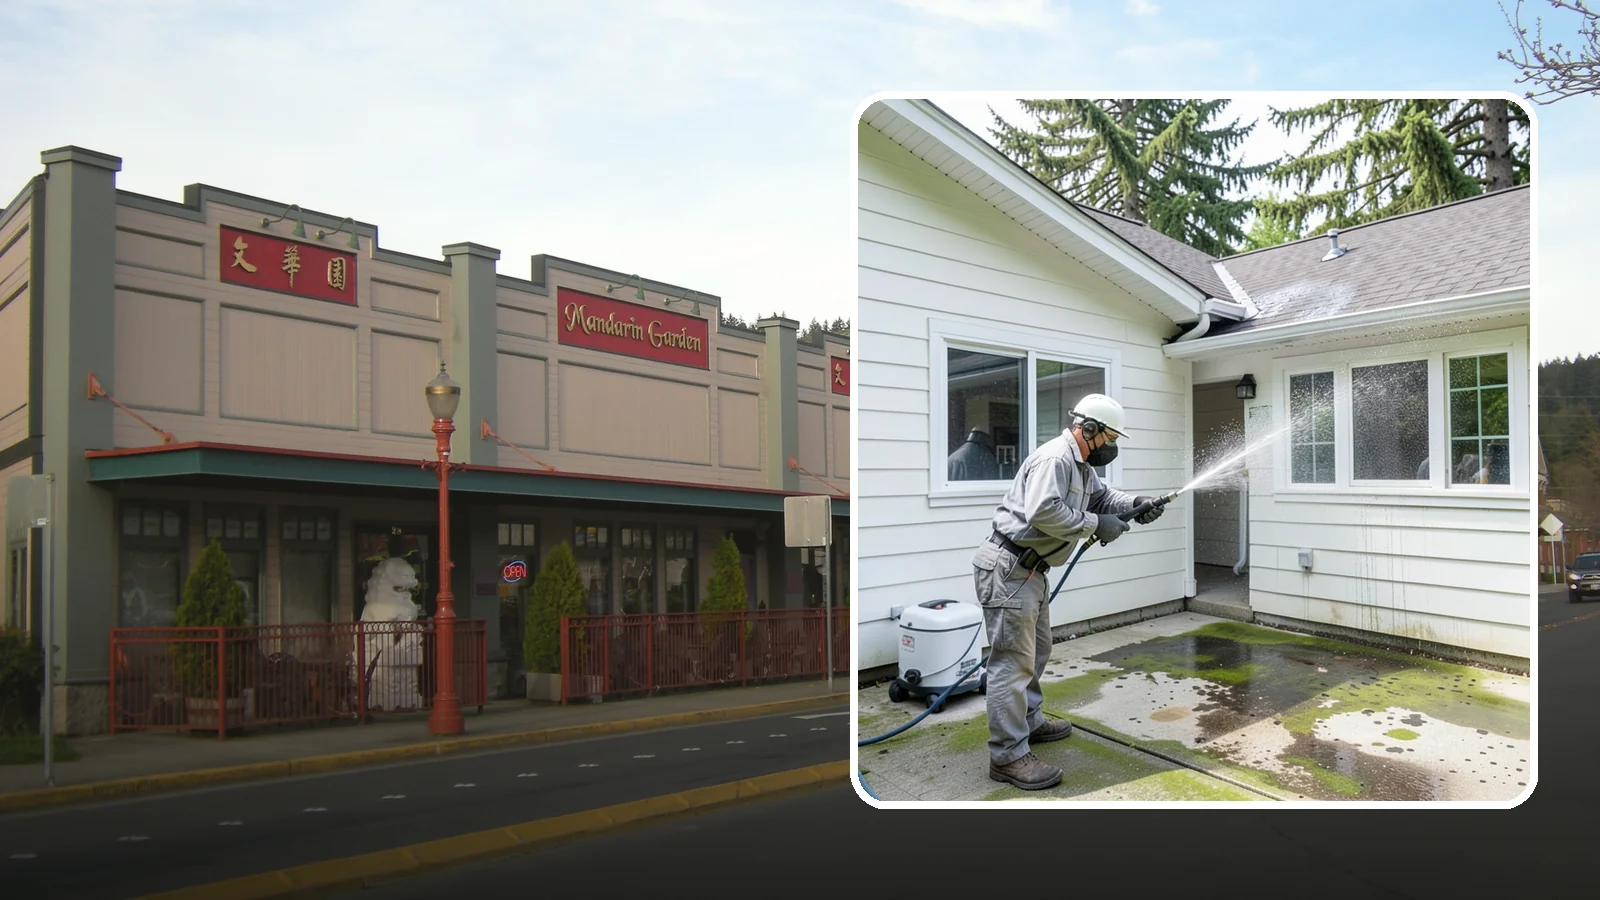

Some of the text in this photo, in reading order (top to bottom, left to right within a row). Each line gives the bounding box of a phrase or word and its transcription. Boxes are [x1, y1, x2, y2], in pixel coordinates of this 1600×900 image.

[231, 235, 346, 291] 文華園
[564, 302, 701, 352] Mandarin Garden
[503, 565, 527, 578] OPEN
